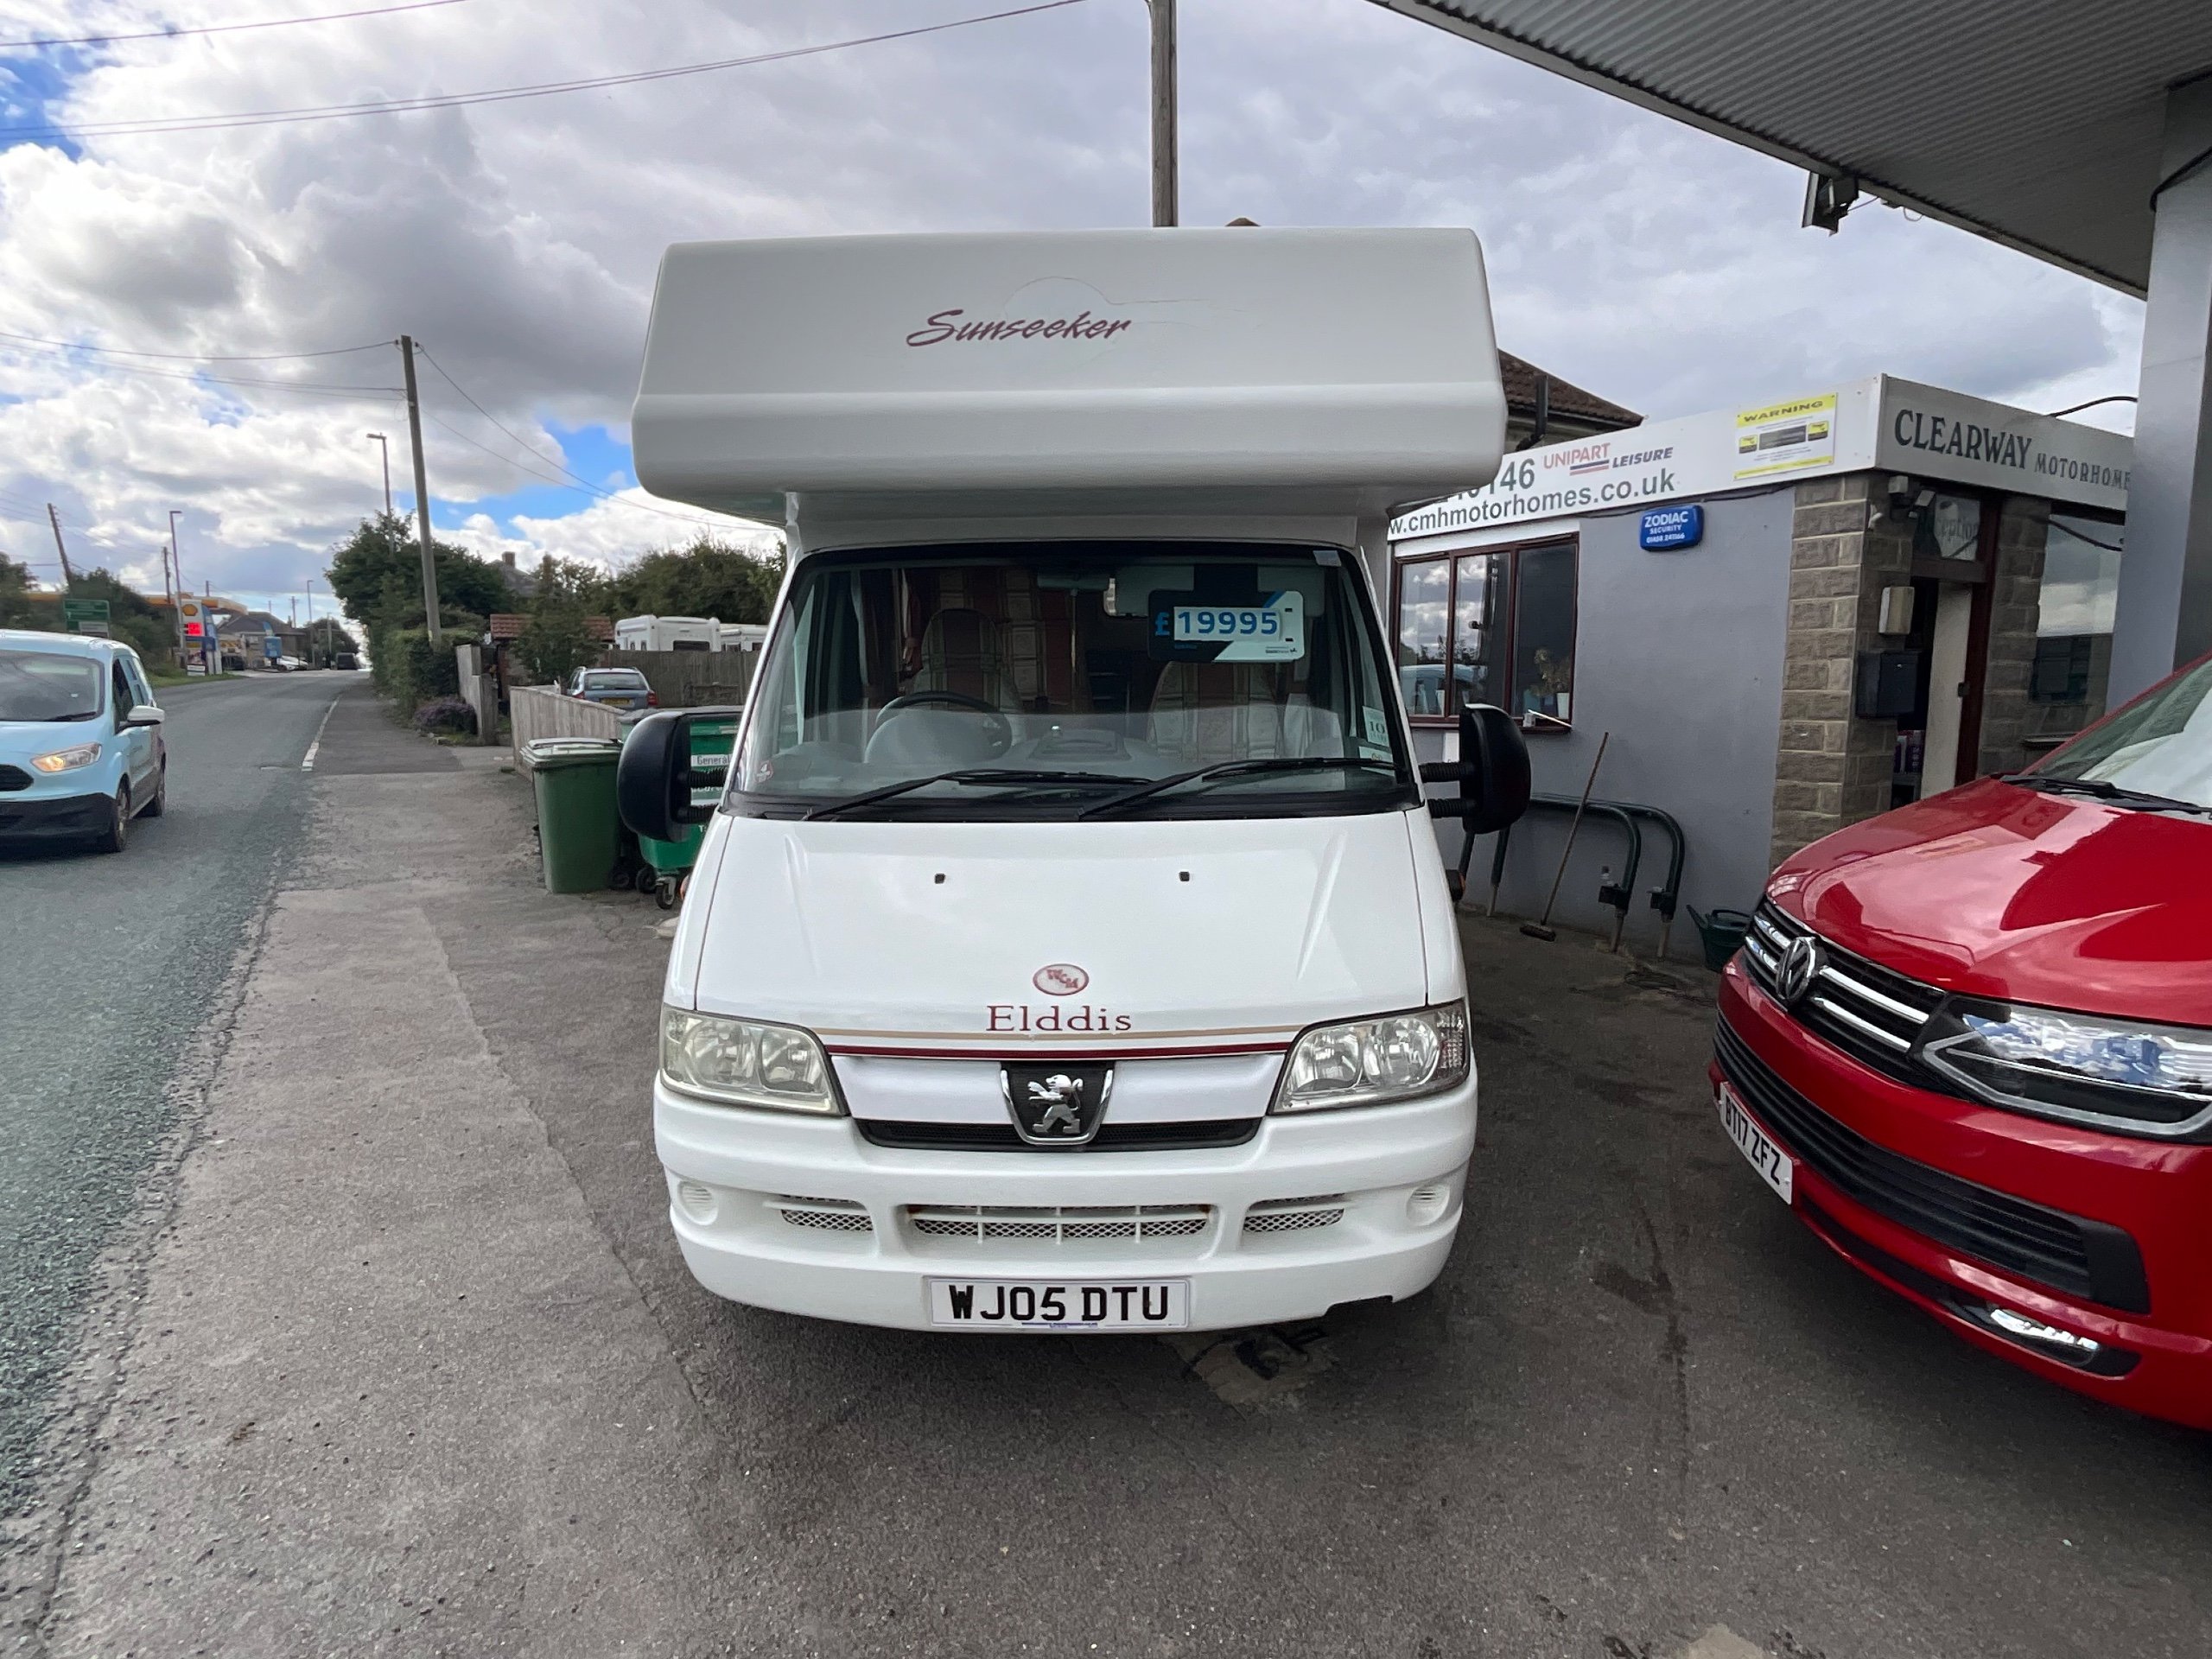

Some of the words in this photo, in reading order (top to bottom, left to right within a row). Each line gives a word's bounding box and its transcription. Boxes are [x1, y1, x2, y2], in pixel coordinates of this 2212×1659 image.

[906, 309, 1131, 346] Sunseeker
[1744, 400, 1823, 423] WARNING
[1894, 409, 2032, 469] CLEARWAY
[1543, 442, 1611, 470] UNIPART
[1612, 446, 1674, 469] LEISURE
[1644, 511, 1689, 528] ZODIAC
[1649, 524, 1682, 534] SECURITY
[986, 1005, 1132, 1032] Elddis
[1751, 1127, 1781, 1185] ZFZ
[949, 1285, 1066, 1321] WJ05
[1081, 1286, 1169, 1321] DTU
